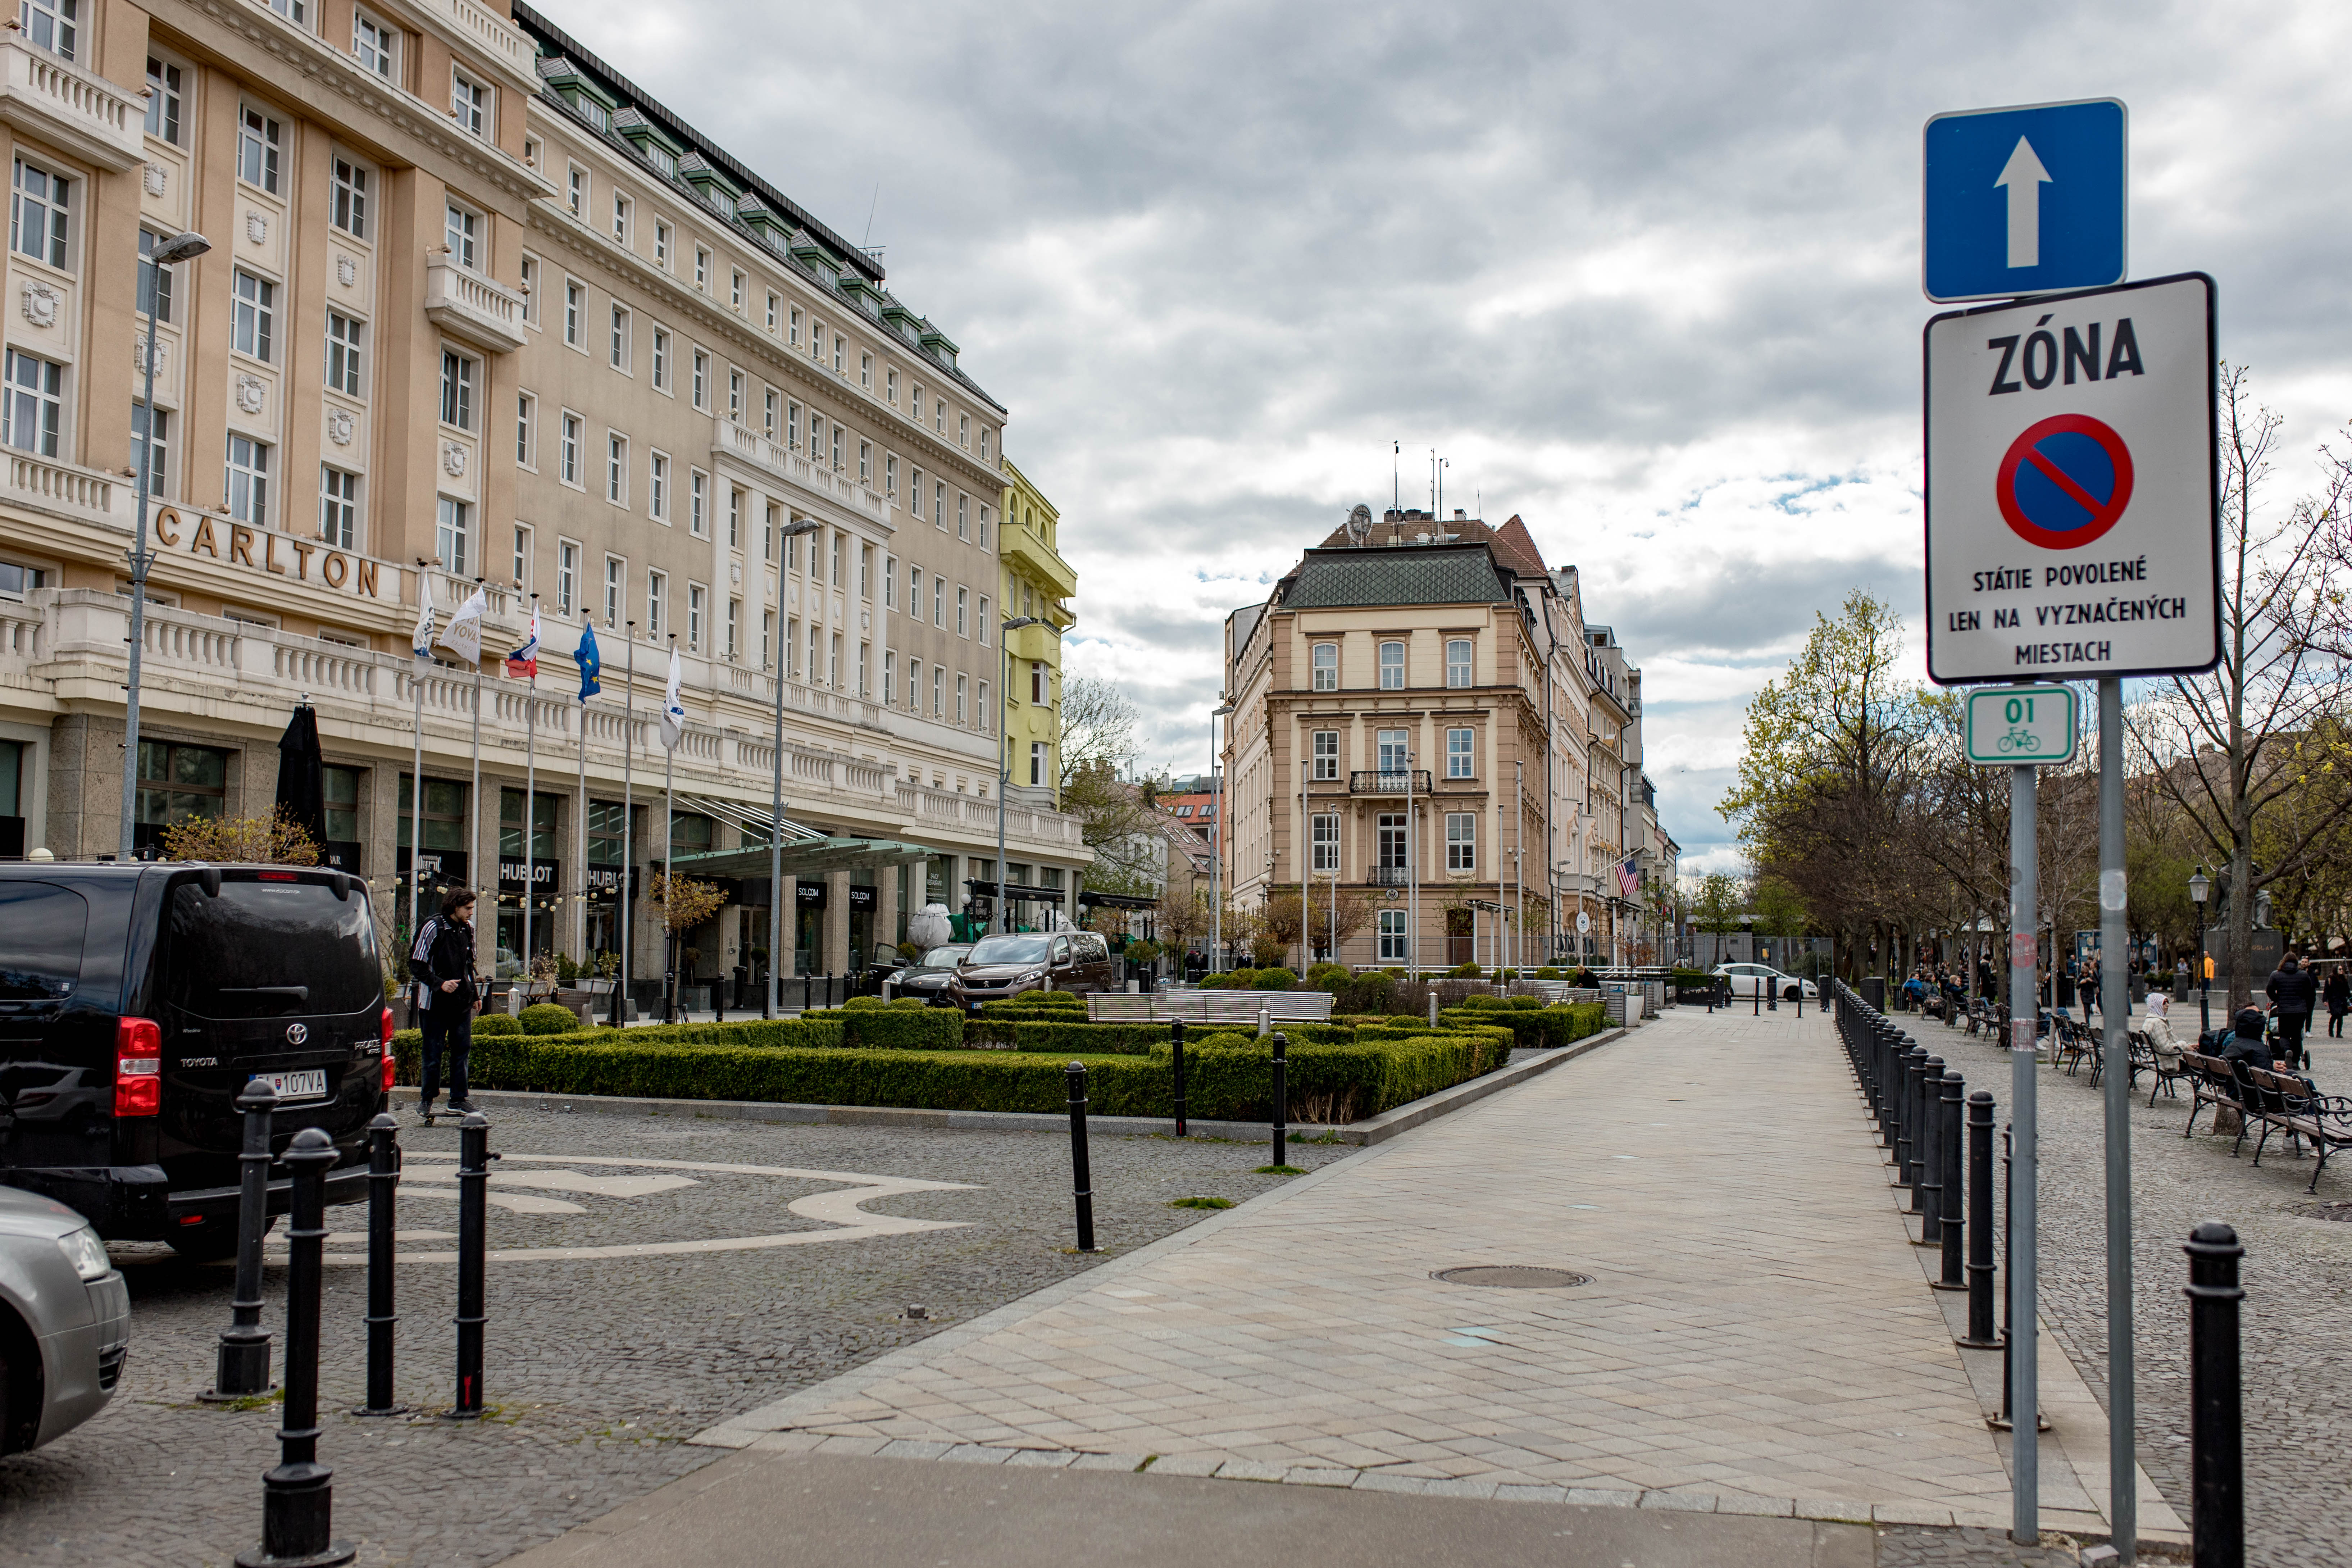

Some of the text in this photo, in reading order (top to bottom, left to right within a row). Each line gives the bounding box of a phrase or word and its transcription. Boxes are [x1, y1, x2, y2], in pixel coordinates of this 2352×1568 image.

[1988, 314, 2145, 396] ZÓNA
[156, 506, 379, 597] CARLTON
[1974, 555, 2146, 591] STÁTIE POVOLENÉ
[1950, 595, 2185, 632] LEN NA VYZNAČENÝCH
[2016, 641, 2110, 665] MIESTACH
[2006, 698, 2034, 724] 01
[500, 863, 552, 882] HUBLOT
[799, 887, 818, 896] SOLOOM
[851, 891, 869, 900] SOLOOM
[354, 1039, 381, 1050] PROACE
[180, 1057, 218, 1067] TOYOTA
[283, 1071, 323, 1094] 107VA
